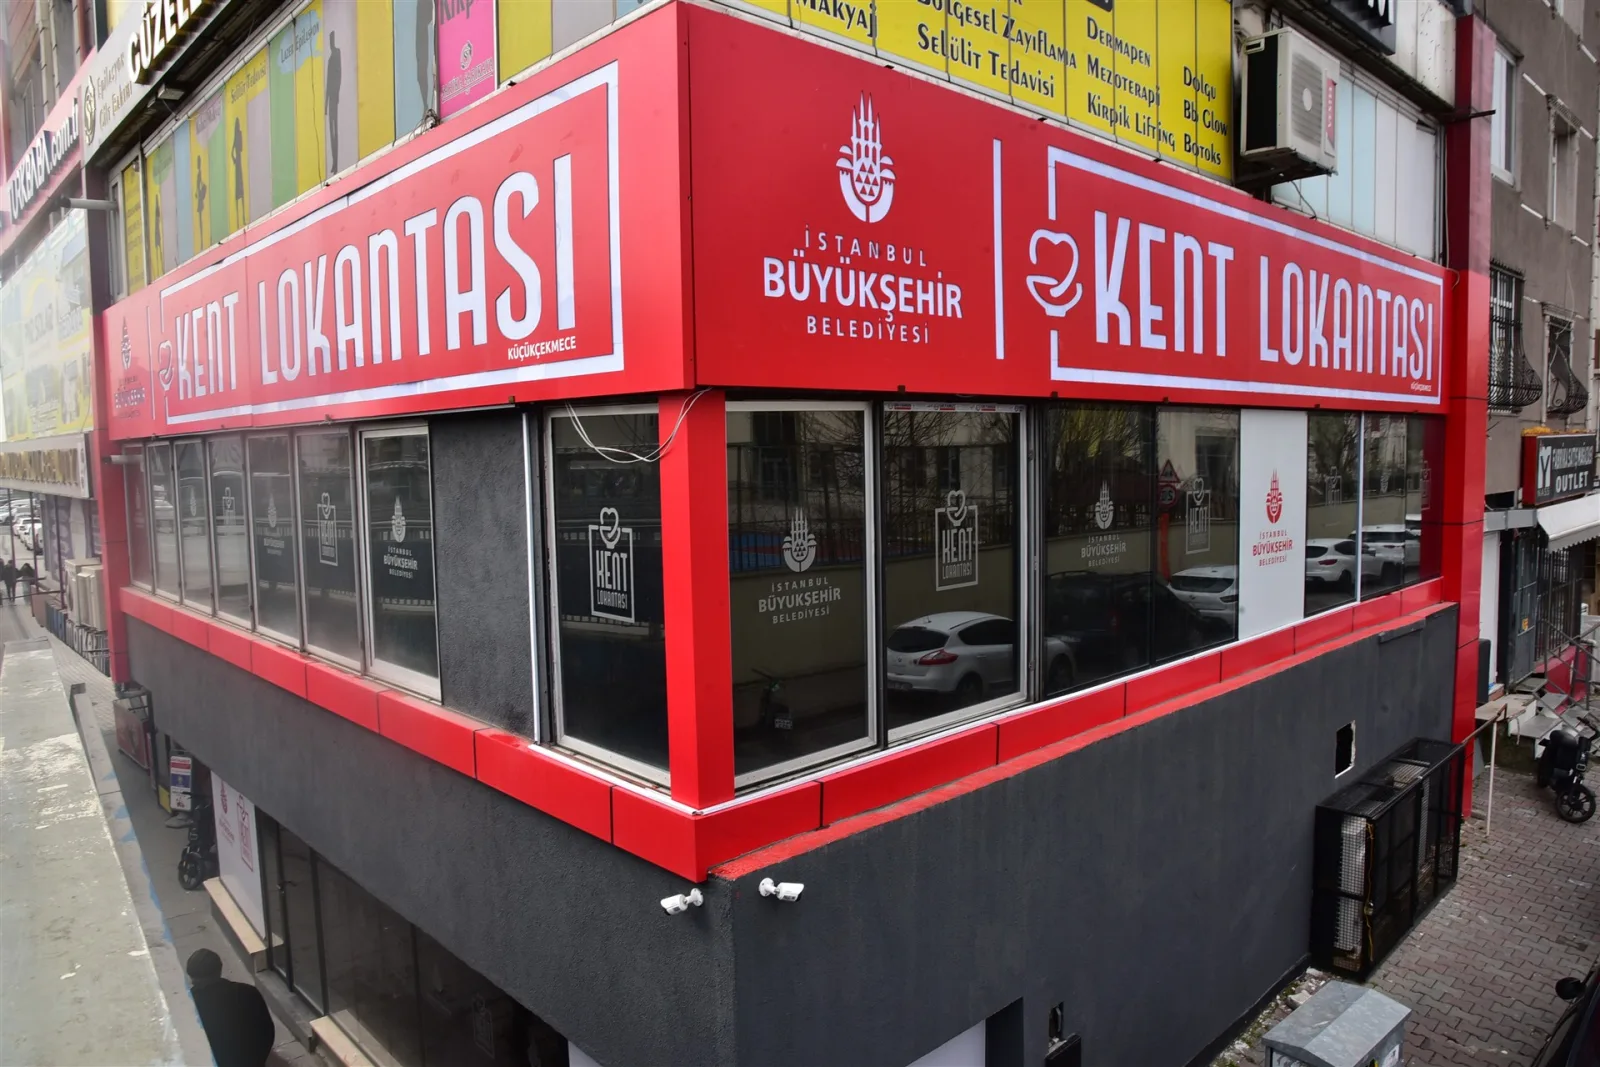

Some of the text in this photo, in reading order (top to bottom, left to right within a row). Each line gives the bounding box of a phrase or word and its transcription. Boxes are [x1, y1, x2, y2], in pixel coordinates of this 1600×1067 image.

[805, 224, 927, 267] İSTANBUL
[175, 153, 576, 401] KENT LOKANTASI
[763, 248, 963, 323] BÜYÜKŞEHİR
[1094, 210, 1433, 381] KENT LOKANTASI
[507, 335, 578, 361] KÜÇÜKÇEKMECE
[806, 315, 930, 345] BELEDİYESİ
[1555, 470, 1589, 493] OUTLET
[942, 527, 973, 565] KENT
[596, 550, 628, 592] KENT
